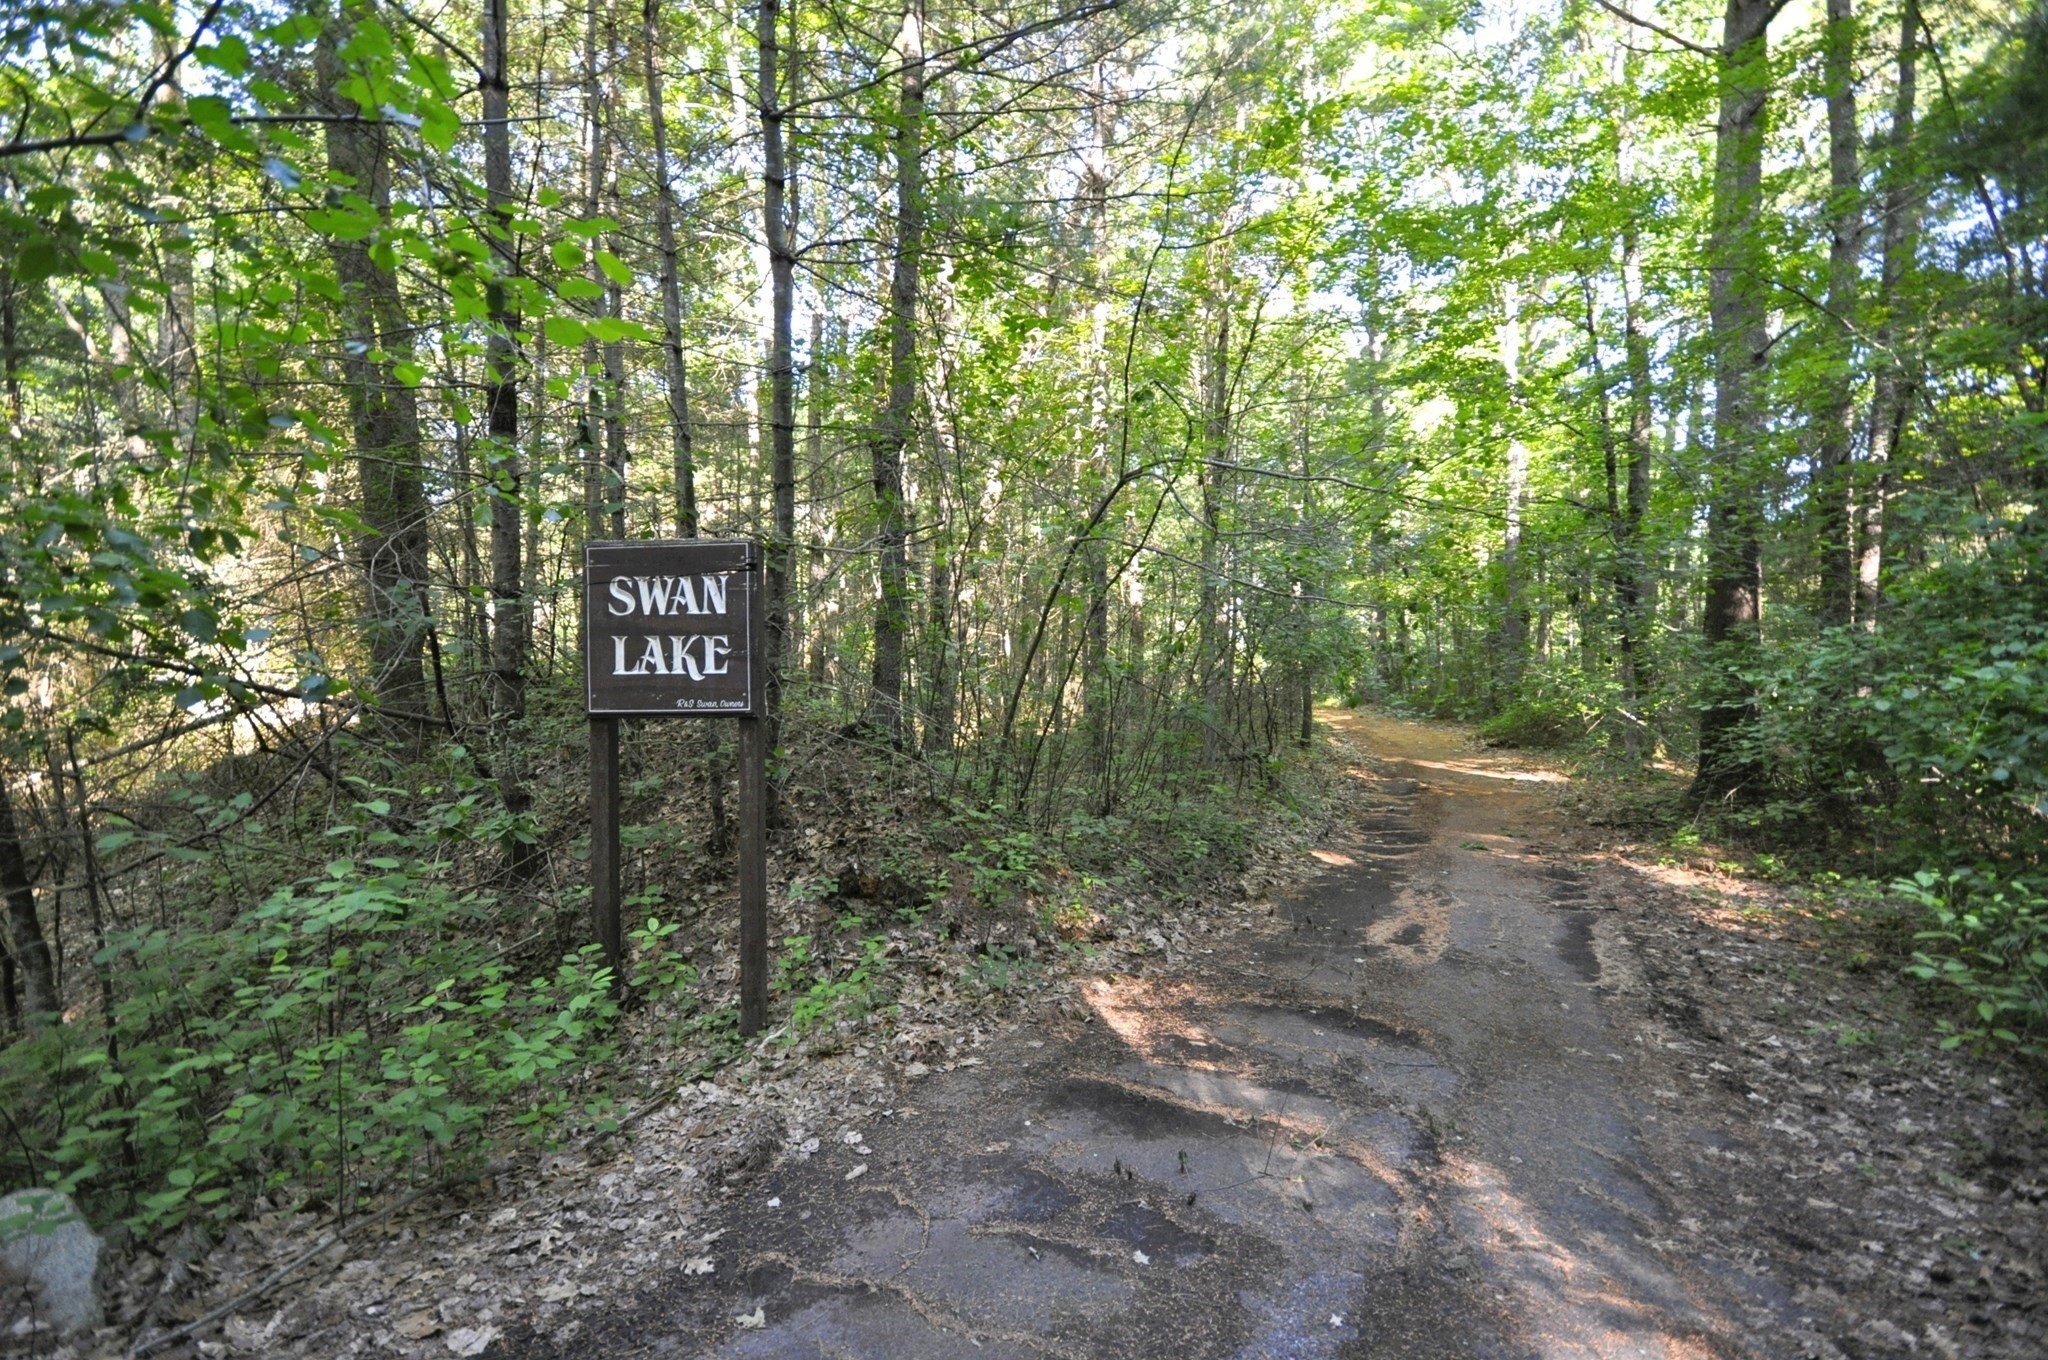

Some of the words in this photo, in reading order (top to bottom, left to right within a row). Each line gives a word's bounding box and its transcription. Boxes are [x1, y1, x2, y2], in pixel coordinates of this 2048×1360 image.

[608, 575, 729, 617] SWAN
[611, 634, 732, 682] LAKE
[696, 699, 719, 709] Swan,
[719, 699, 744, 708] Owners
